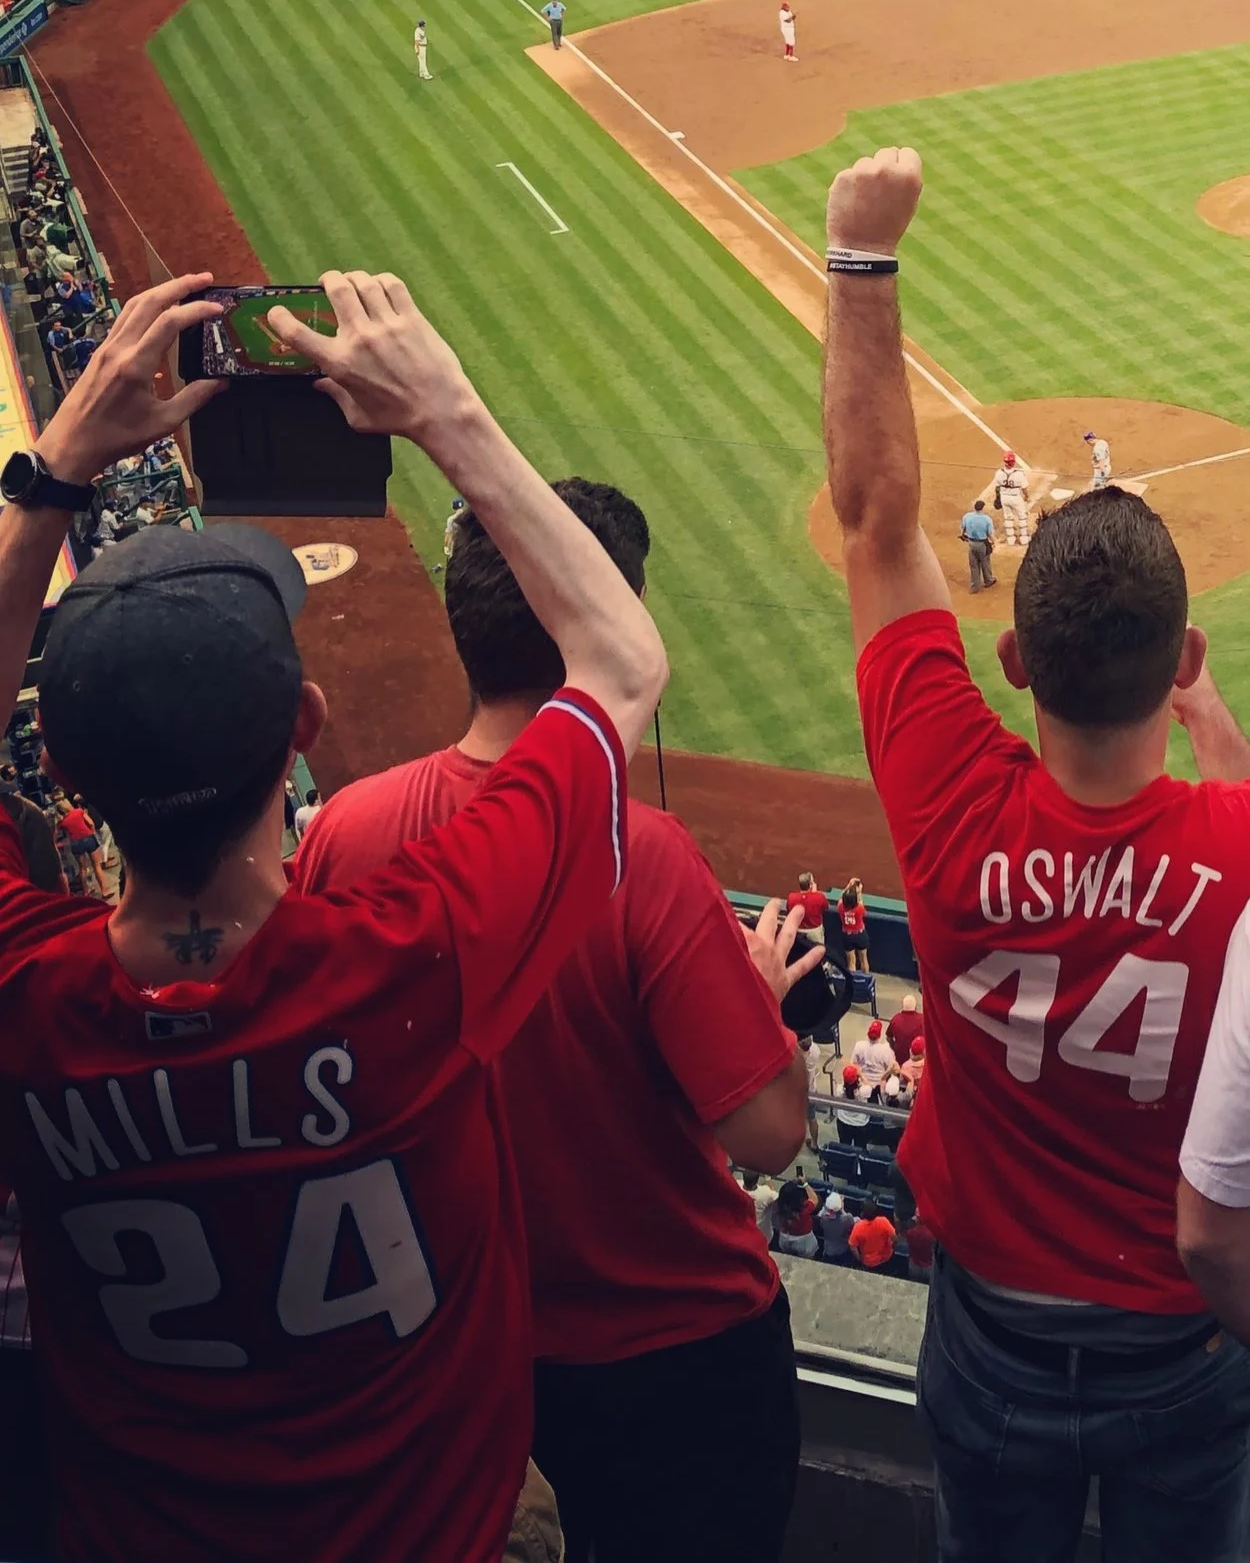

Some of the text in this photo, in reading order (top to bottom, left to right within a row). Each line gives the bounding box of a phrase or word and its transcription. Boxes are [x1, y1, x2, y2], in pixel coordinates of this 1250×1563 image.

[980, 845, 1222, 936] OSWALT
[949, 950, 1189, 1103] 44
[25, 1046, 353, 1181] MILLS
[61, 1158, 437, 1368] 24
